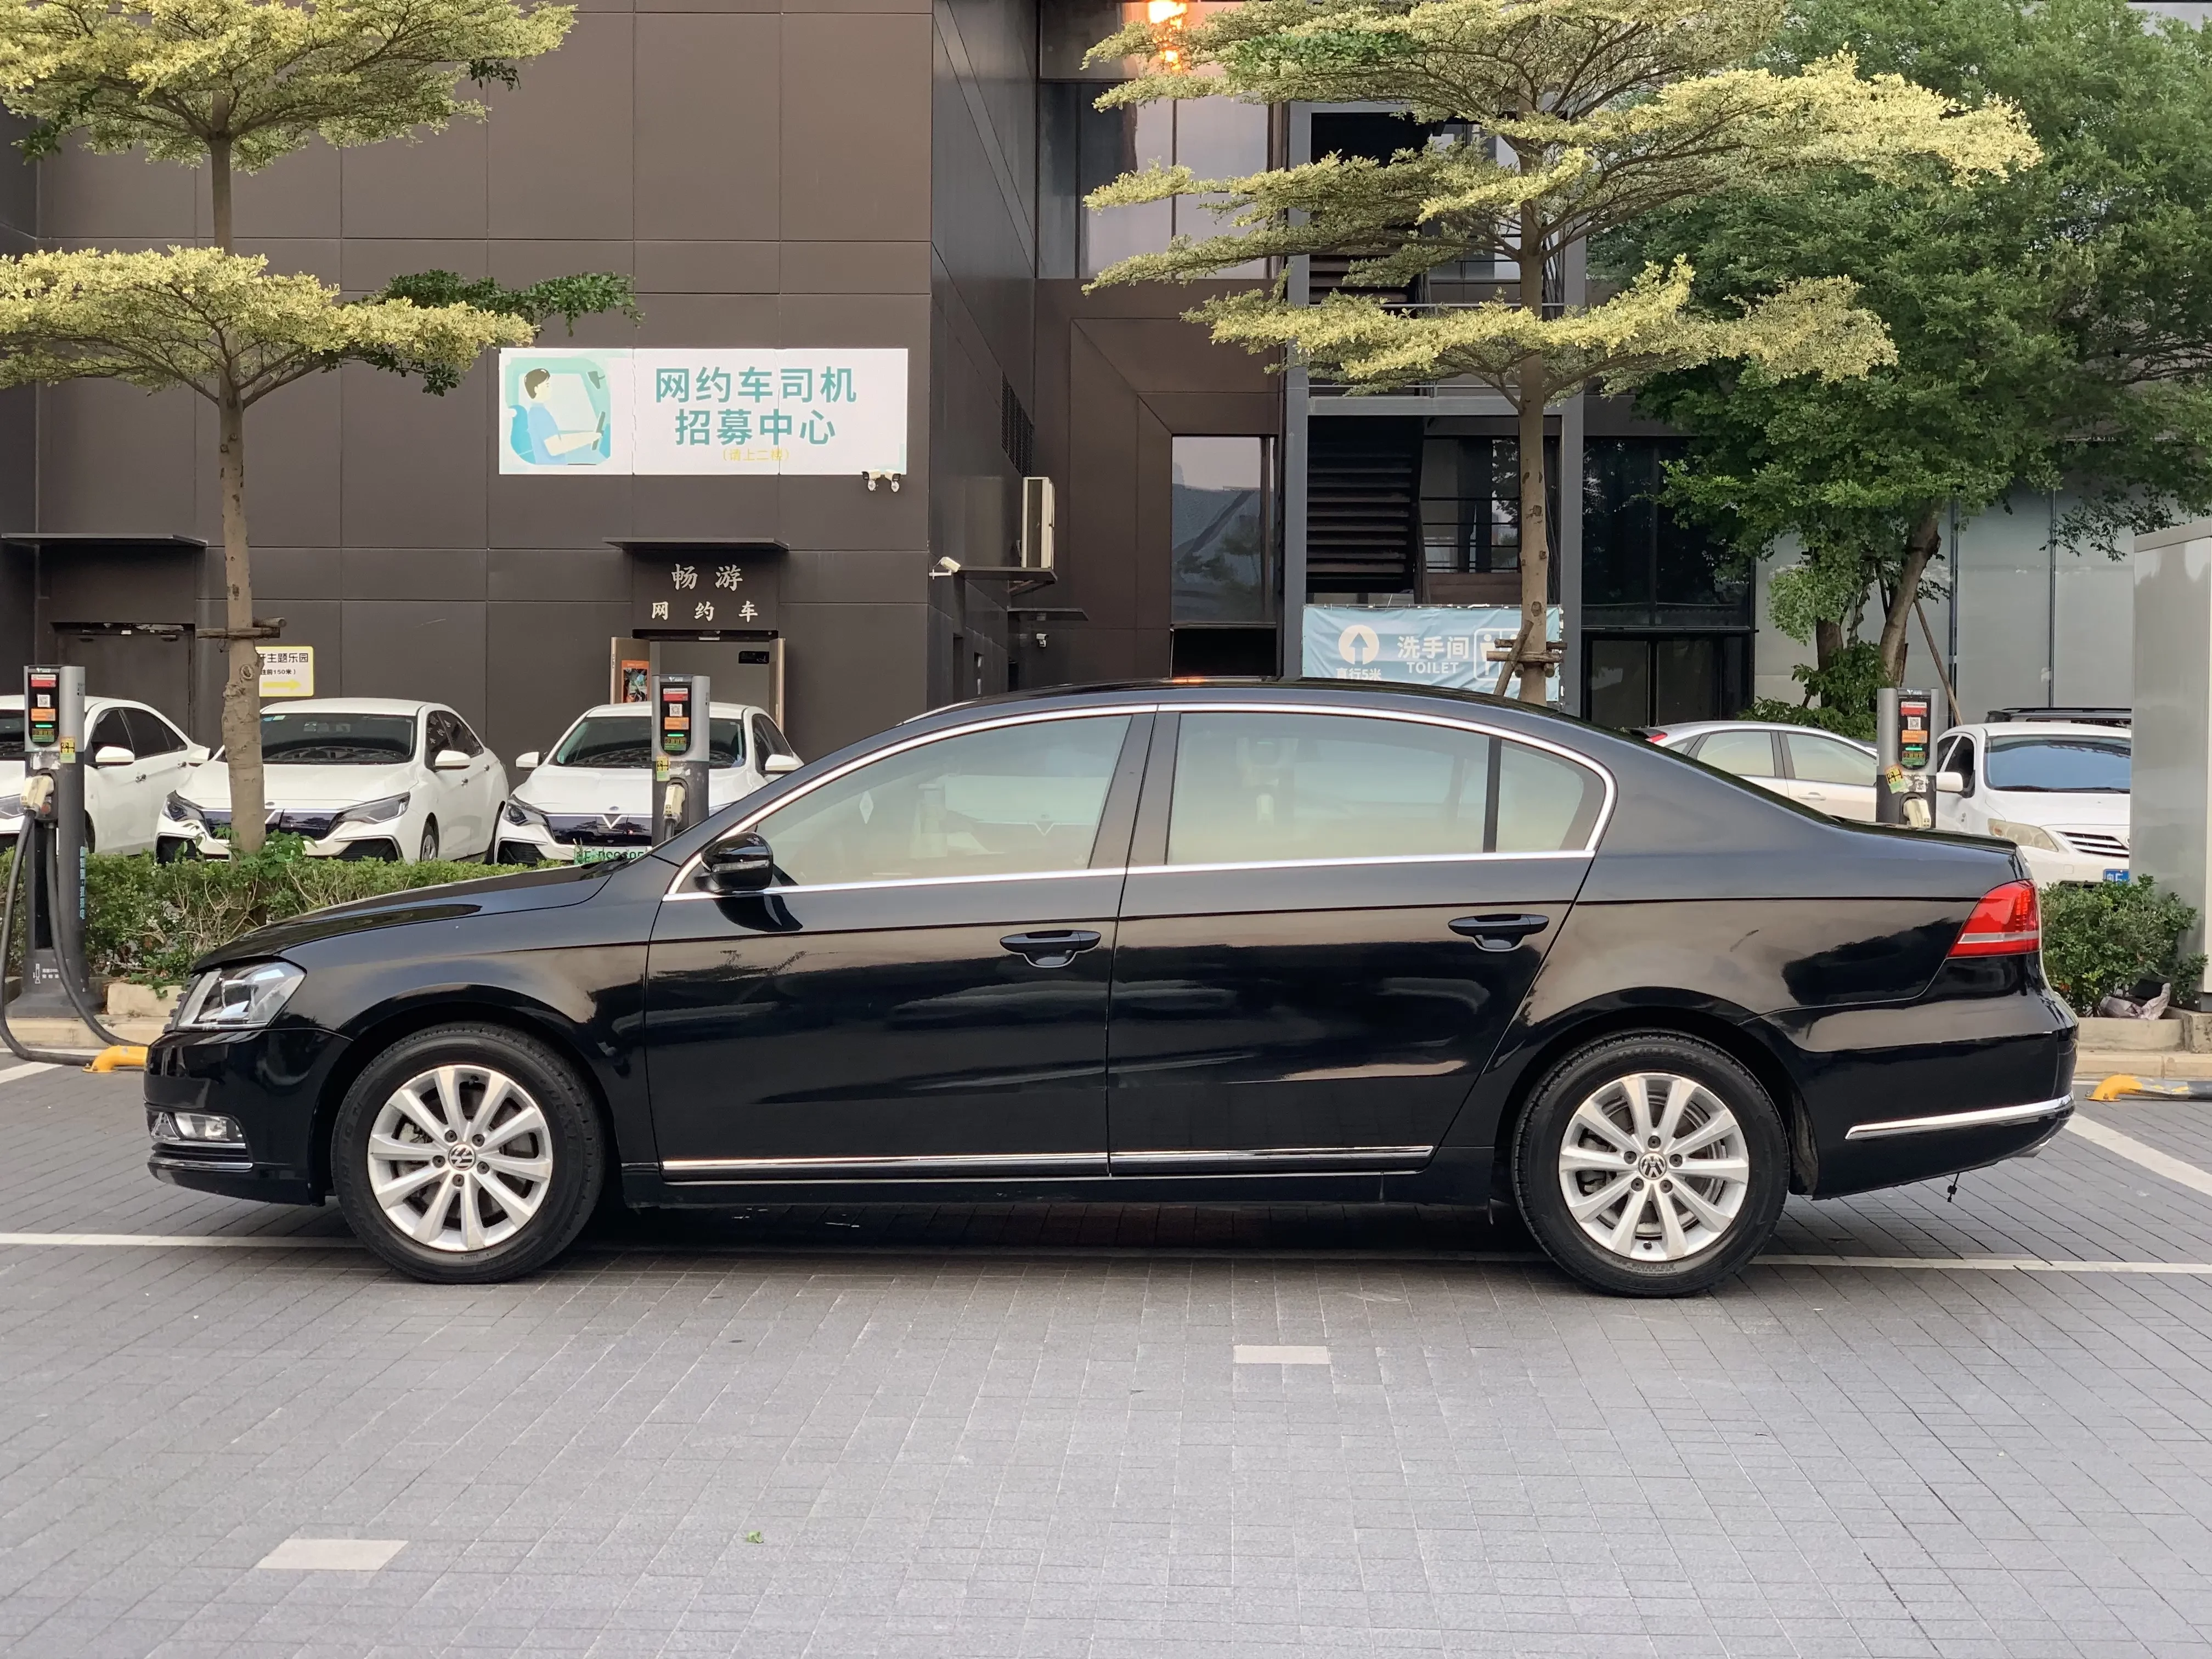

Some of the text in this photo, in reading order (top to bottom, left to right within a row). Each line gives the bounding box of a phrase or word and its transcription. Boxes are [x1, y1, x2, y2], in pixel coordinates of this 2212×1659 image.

[655, 366, 857, 403] 网约车司机
[674, 409, 836, 445] 招募中心
[671, 563, 743, 591] 畅游
[651, 600, 758, 623] 网约车
[1397, 635, 1469, 660] 洗手间
[1406, 661, 1459, 674] TOILET
